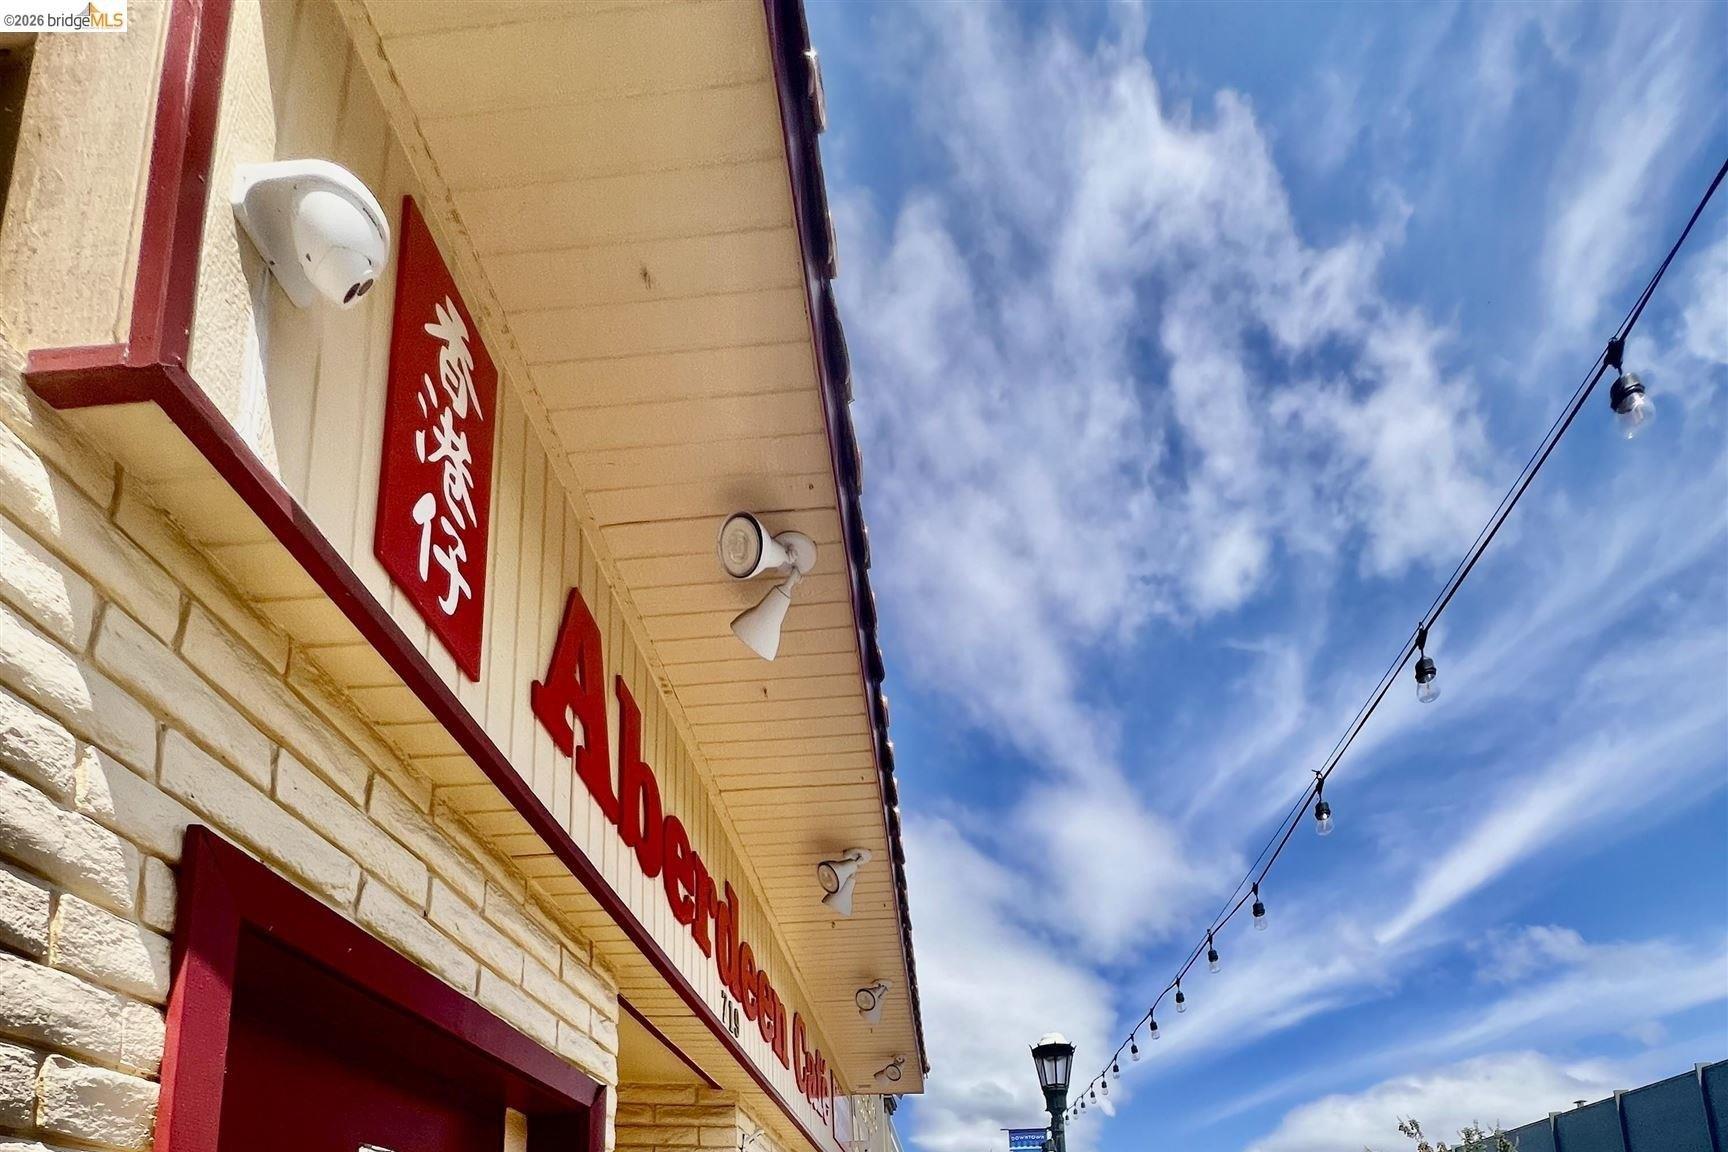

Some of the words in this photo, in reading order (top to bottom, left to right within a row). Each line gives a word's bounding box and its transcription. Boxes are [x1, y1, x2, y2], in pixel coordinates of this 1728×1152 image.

[412, 296, 484, 616] 香港仔
[531, 587, 789, 1070] Aberdeen
[720, 989, 740, 1039] 719
